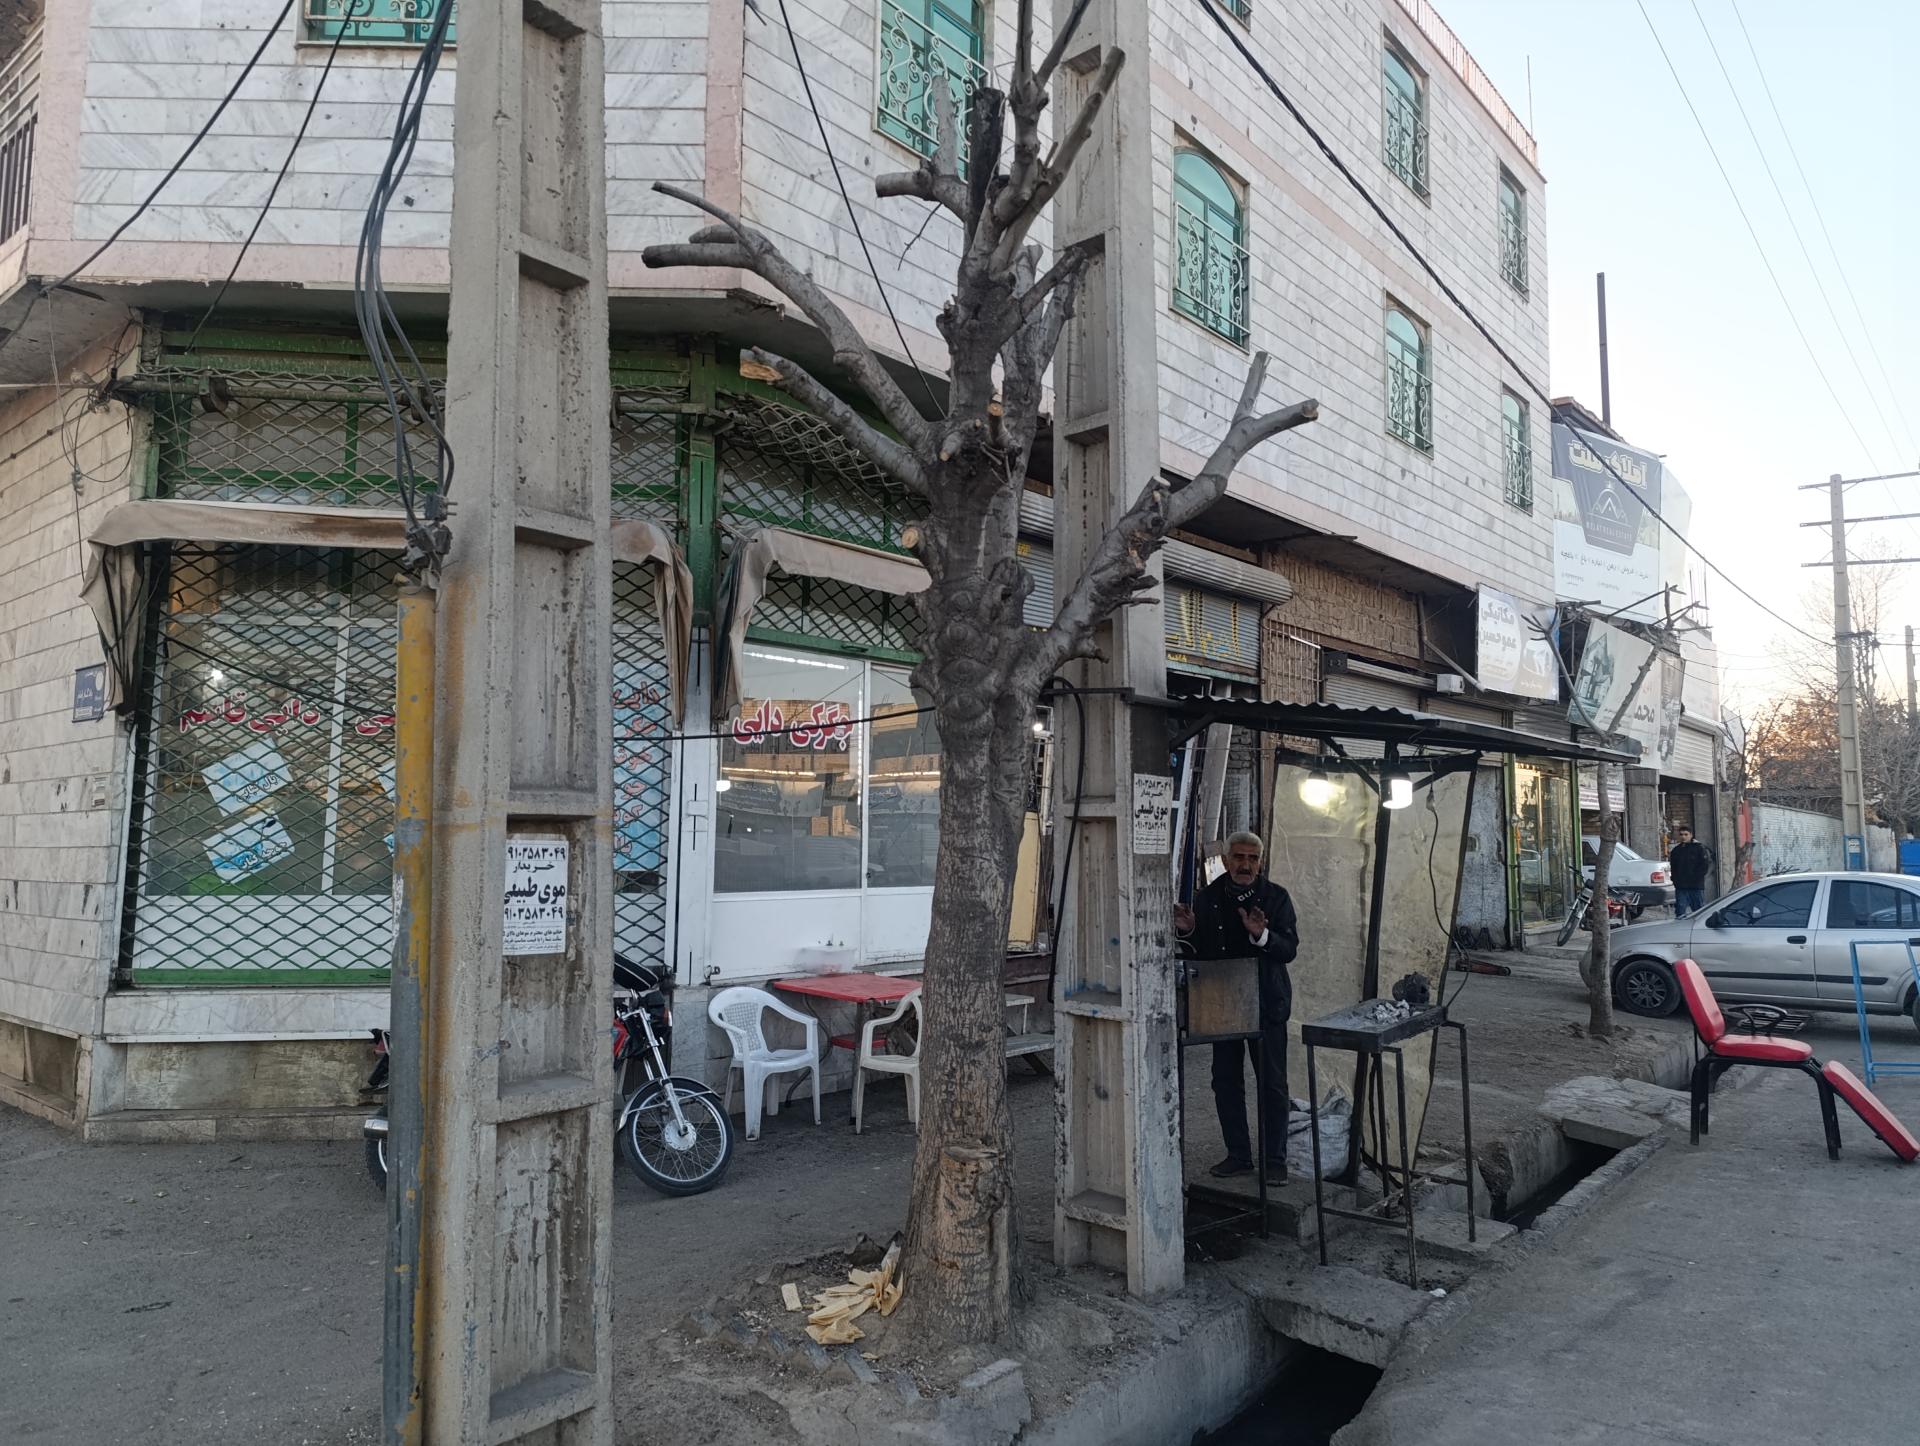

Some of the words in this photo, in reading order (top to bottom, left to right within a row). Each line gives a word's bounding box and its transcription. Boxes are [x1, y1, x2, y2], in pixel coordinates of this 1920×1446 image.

[732, 697, 783, 744] دایی
[790, 702, 854, 751] جگرکی
[1135, 799, 1154, 819] طبیعی
[1154, 806, 1169, 821] موی
[512, 861, 555, 873] خریدار
[503, 876, 538, 905] طبیعی
[538, 884, 566, 905] موی
